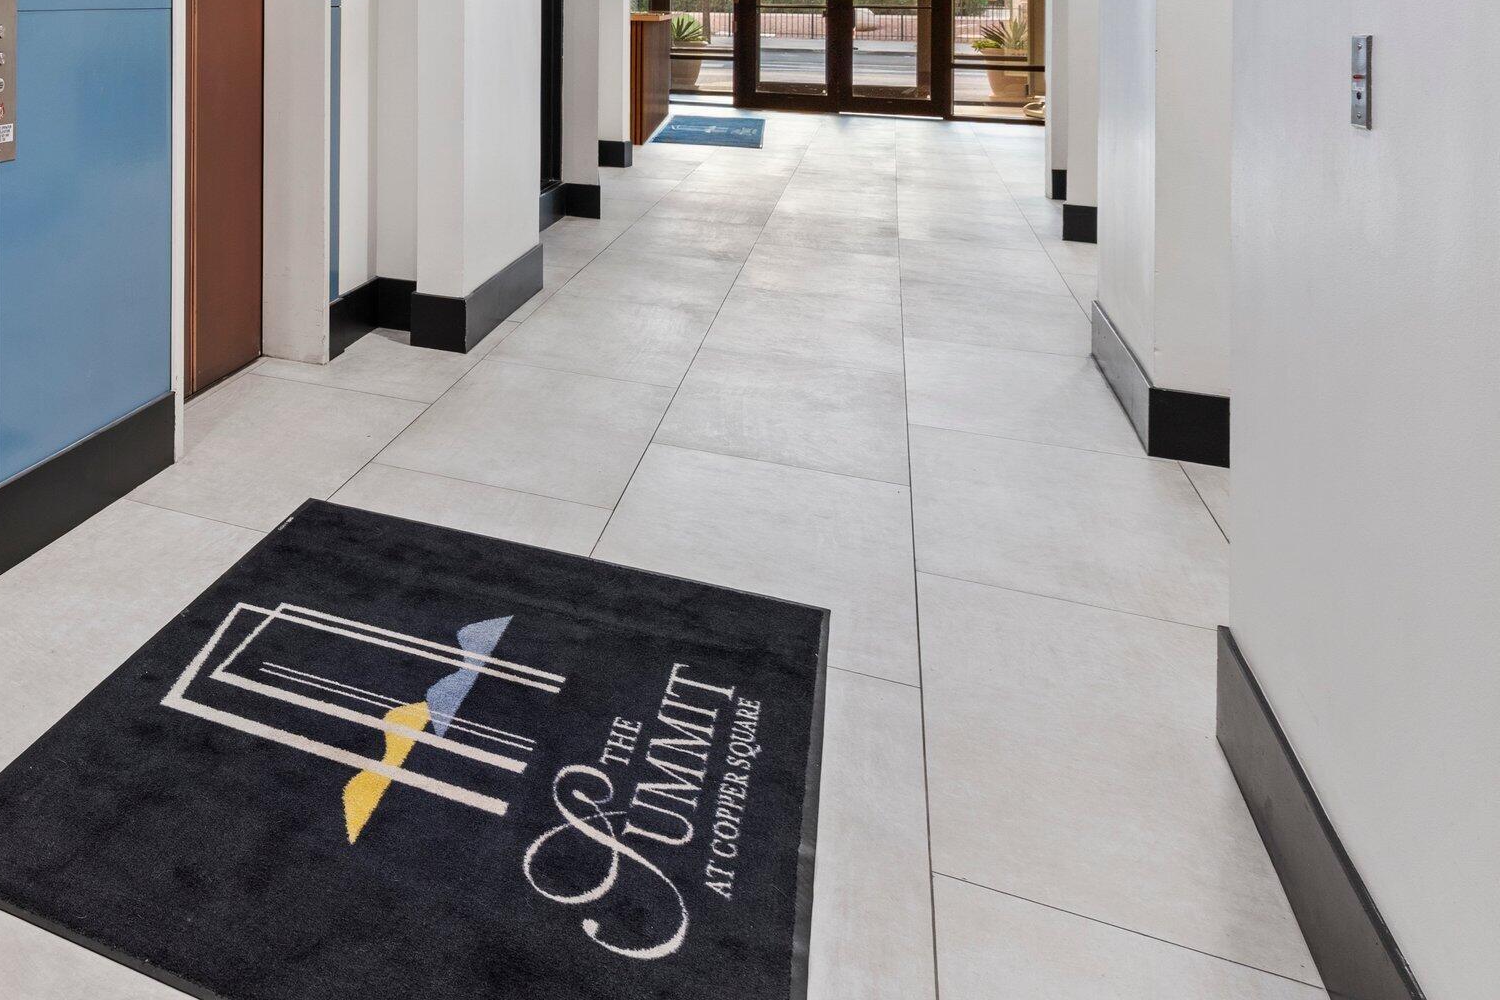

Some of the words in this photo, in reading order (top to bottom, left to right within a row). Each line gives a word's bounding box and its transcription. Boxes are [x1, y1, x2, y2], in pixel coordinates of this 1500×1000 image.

[600, 716, 643, 767] THE
[726, 696, 763, 771] SQUARE
[523, 663, 735, 959] SUMMIT
[711, 772, 751, 859] COPPER
[705, 859, 736, 900] AT
